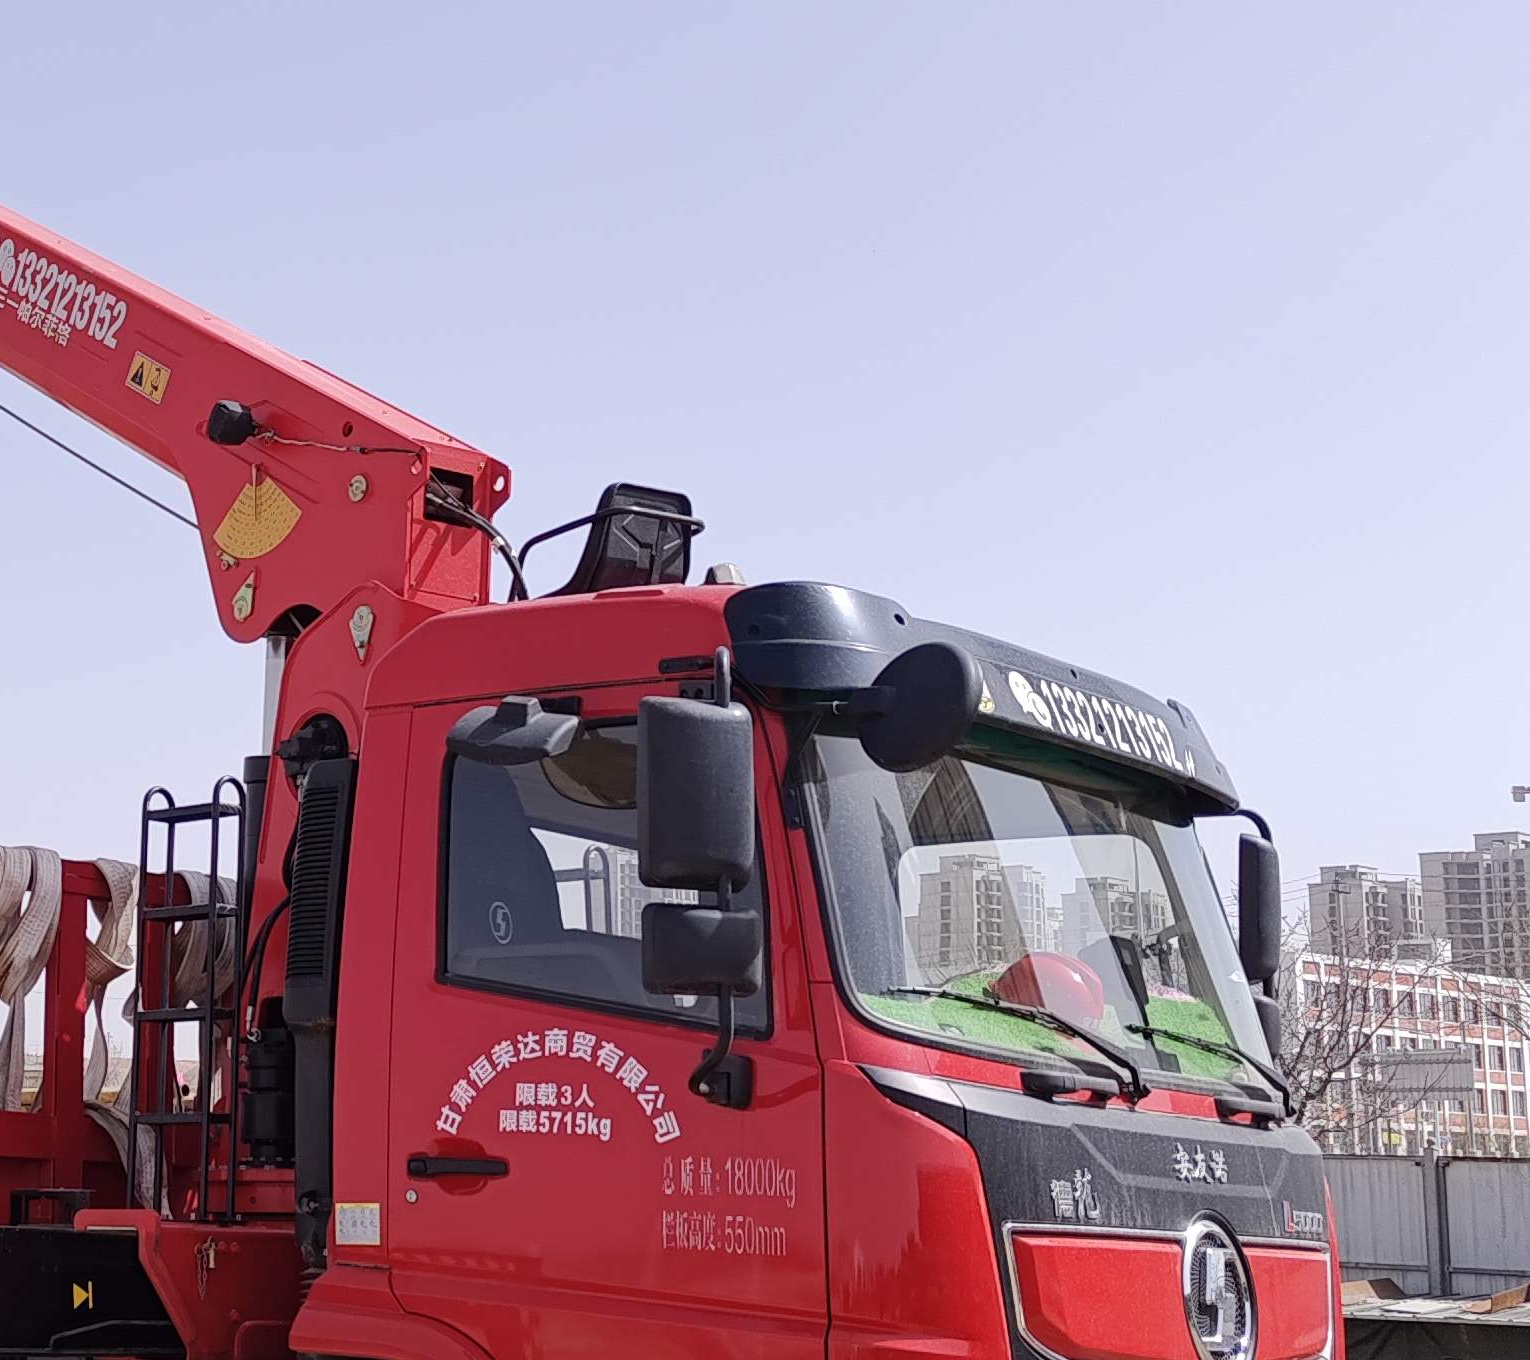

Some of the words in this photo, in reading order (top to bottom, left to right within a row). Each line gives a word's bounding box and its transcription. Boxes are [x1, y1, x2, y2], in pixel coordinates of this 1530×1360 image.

[11, 248, 127, 350] 13321213152
[1040, 680, 1184, 772] 13321213152
[436, 1027, 681, 1144] 甘肃恒荣达商贸有限公司
[499, 1110, 612, 1141] 限载5715kg
